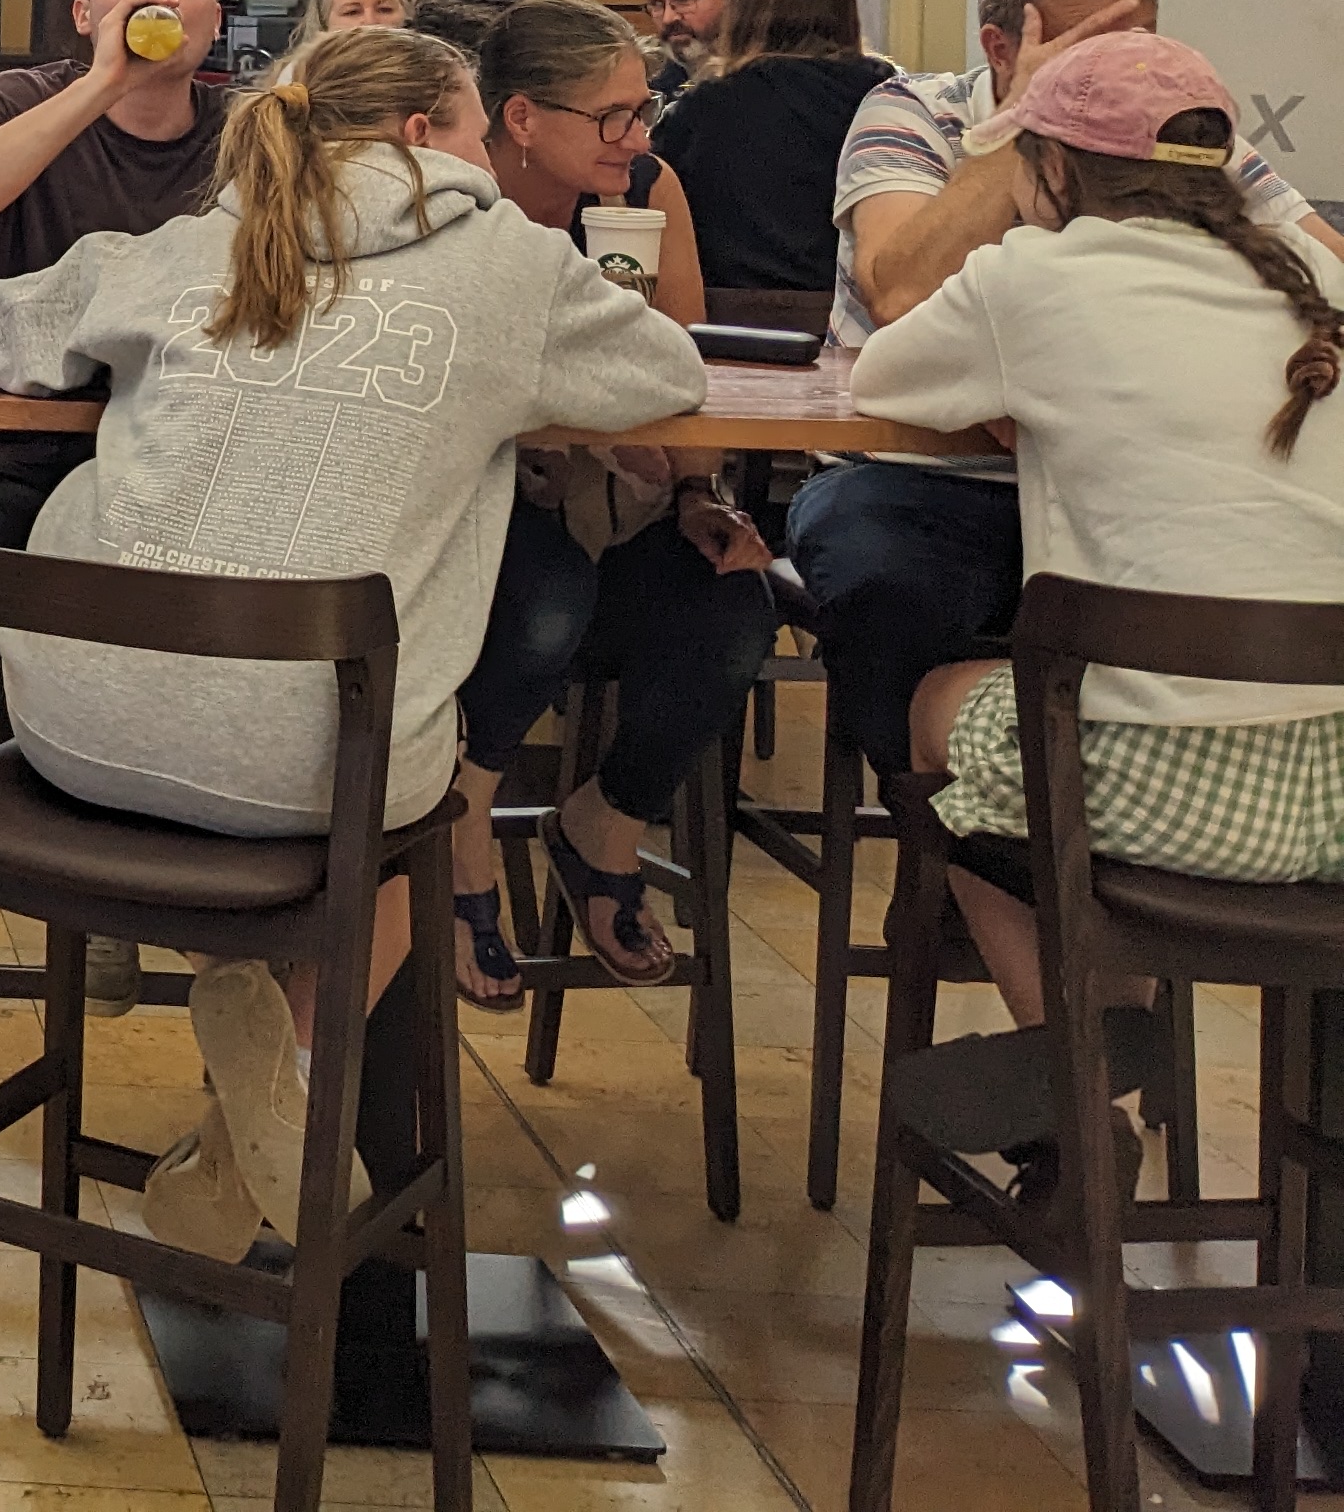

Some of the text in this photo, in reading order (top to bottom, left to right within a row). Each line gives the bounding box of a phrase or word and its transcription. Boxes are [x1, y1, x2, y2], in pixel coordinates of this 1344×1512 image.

[1247, 94, 1305, 152] X
[359, 278, 394, 292] OF
[160, 285, 457, 412] 2023
[132, 540, 250, 578] COLCHESTER
